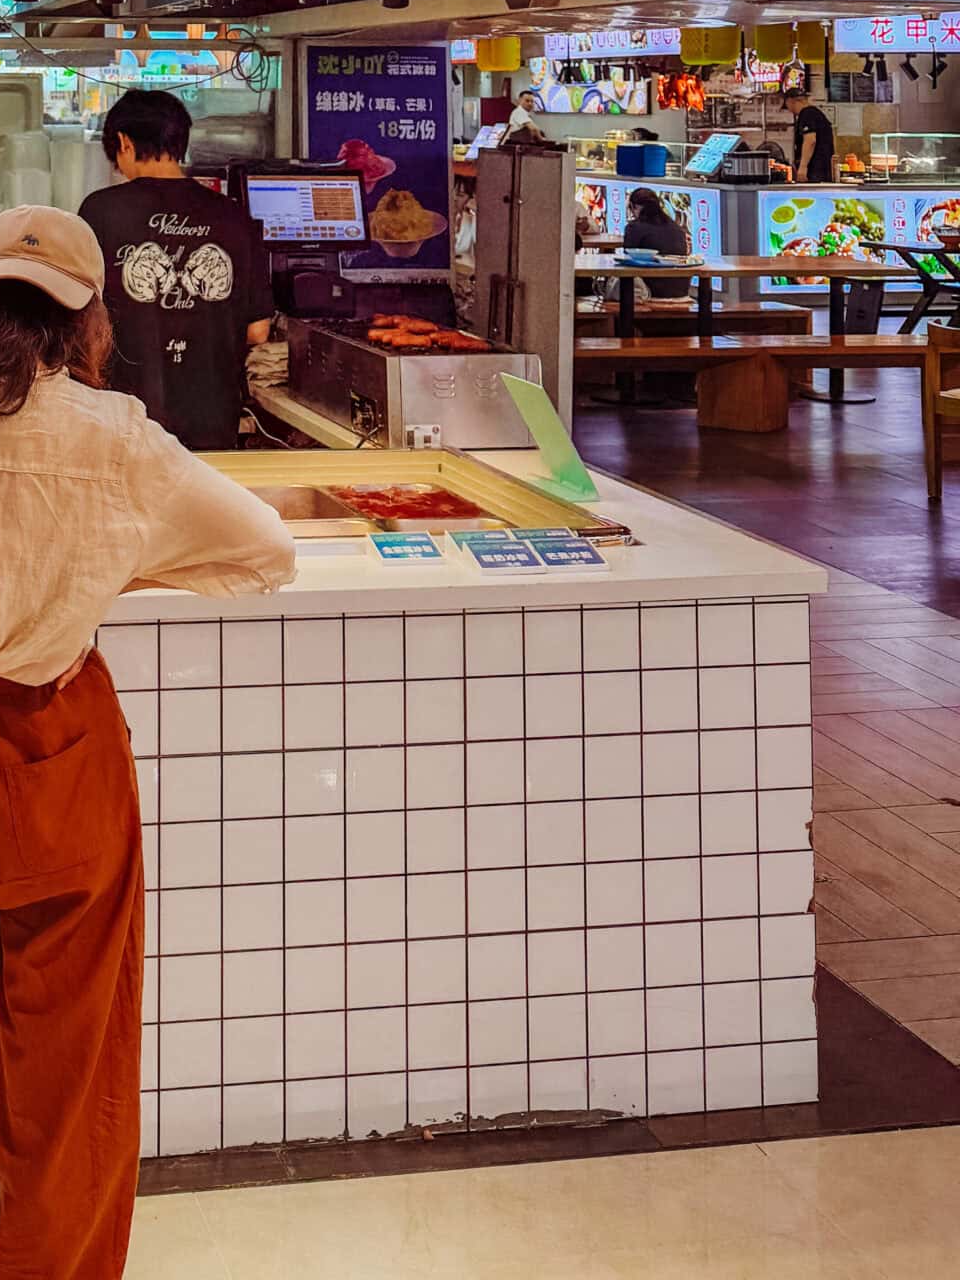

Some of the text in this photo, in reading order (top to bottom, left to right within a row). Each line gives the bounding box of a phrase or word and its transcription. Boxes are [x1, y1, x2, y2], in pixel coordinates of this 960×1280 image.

[315, 91, 365, 112] 绵绵冰
[378, 119, 436, 140] 18元/份
